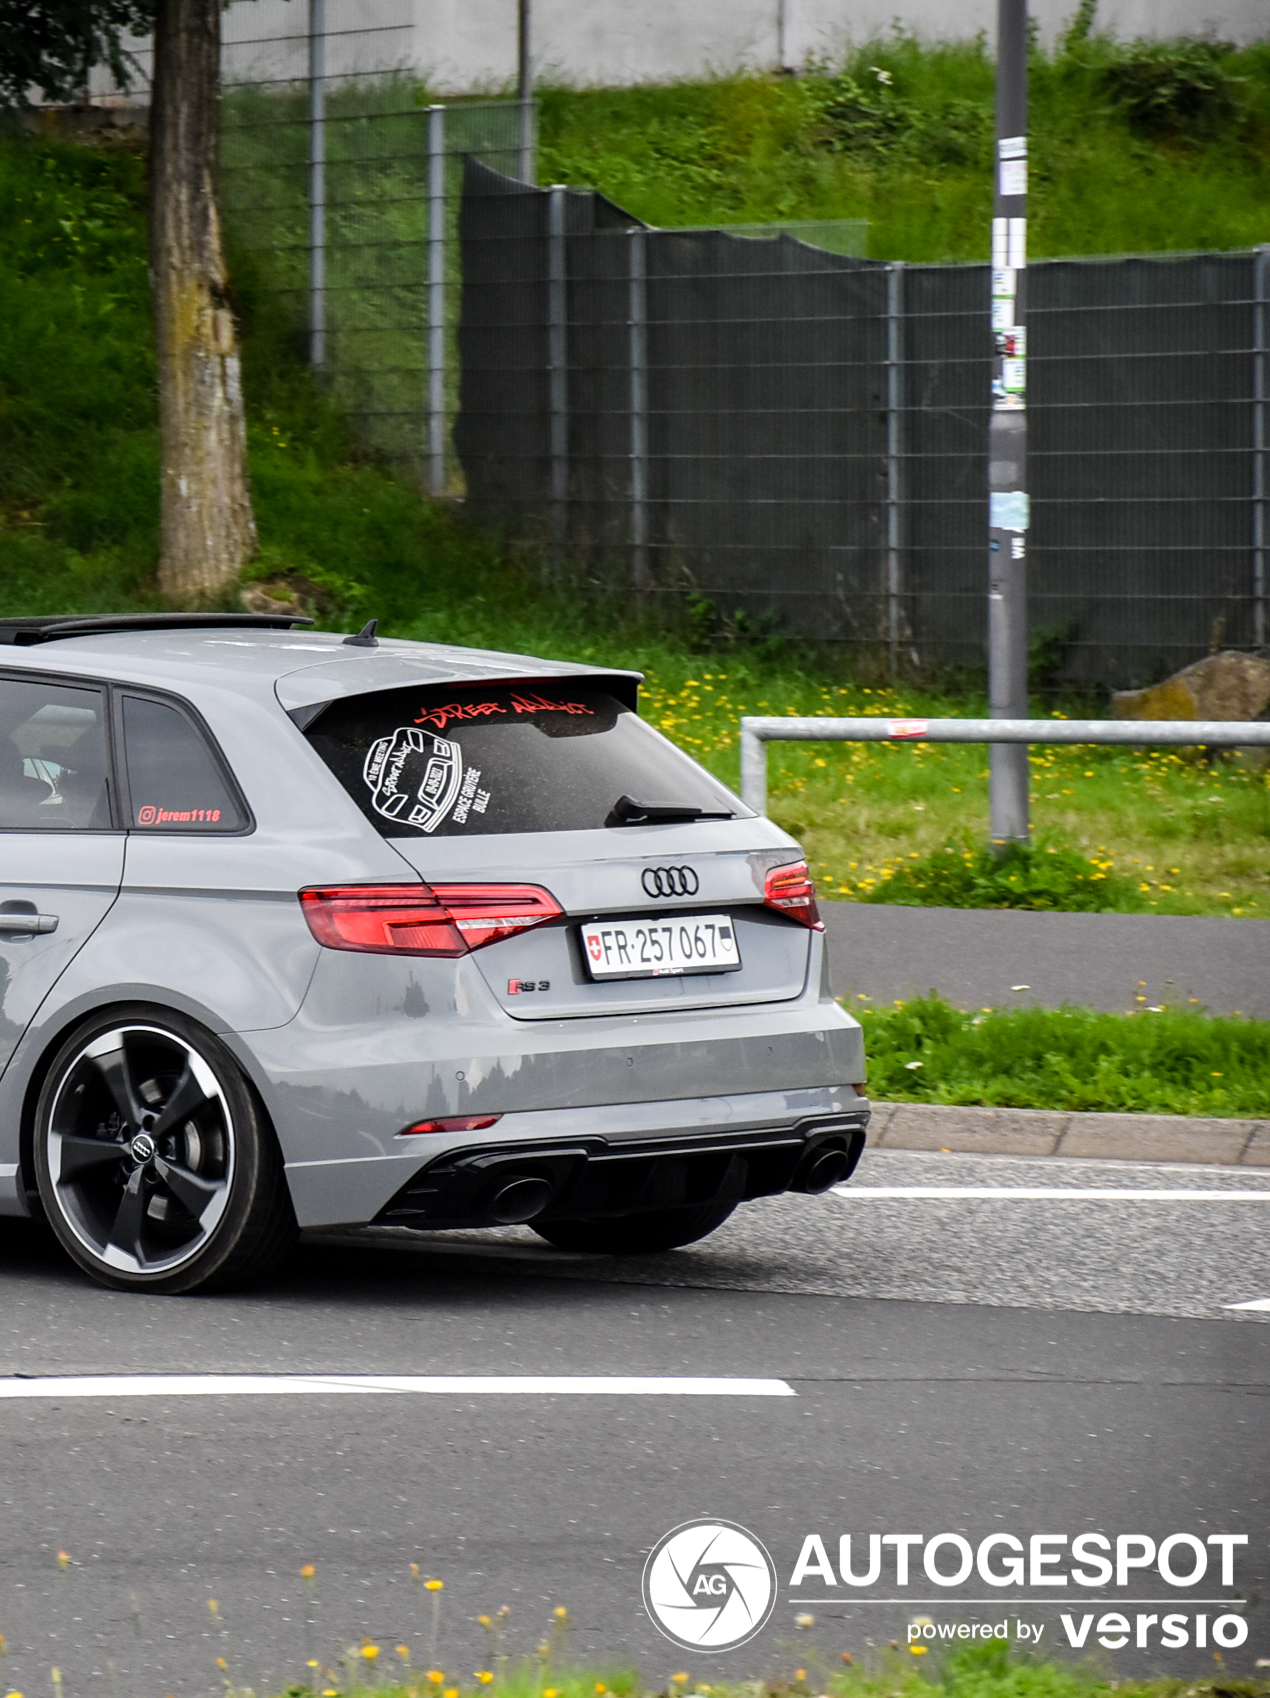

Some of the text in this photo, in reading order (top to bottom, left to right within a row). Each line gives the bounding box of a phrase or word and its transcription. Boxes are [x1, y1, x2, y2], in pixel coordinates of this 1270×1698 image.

[376, 741, 389, 763] MEETING
[452, 795, 472, 824] ESPACE
[471, 788, 491, 814] BULLE
[155, 808, 221, 825] jerem1118
[508, 979, 536, 995] RS
